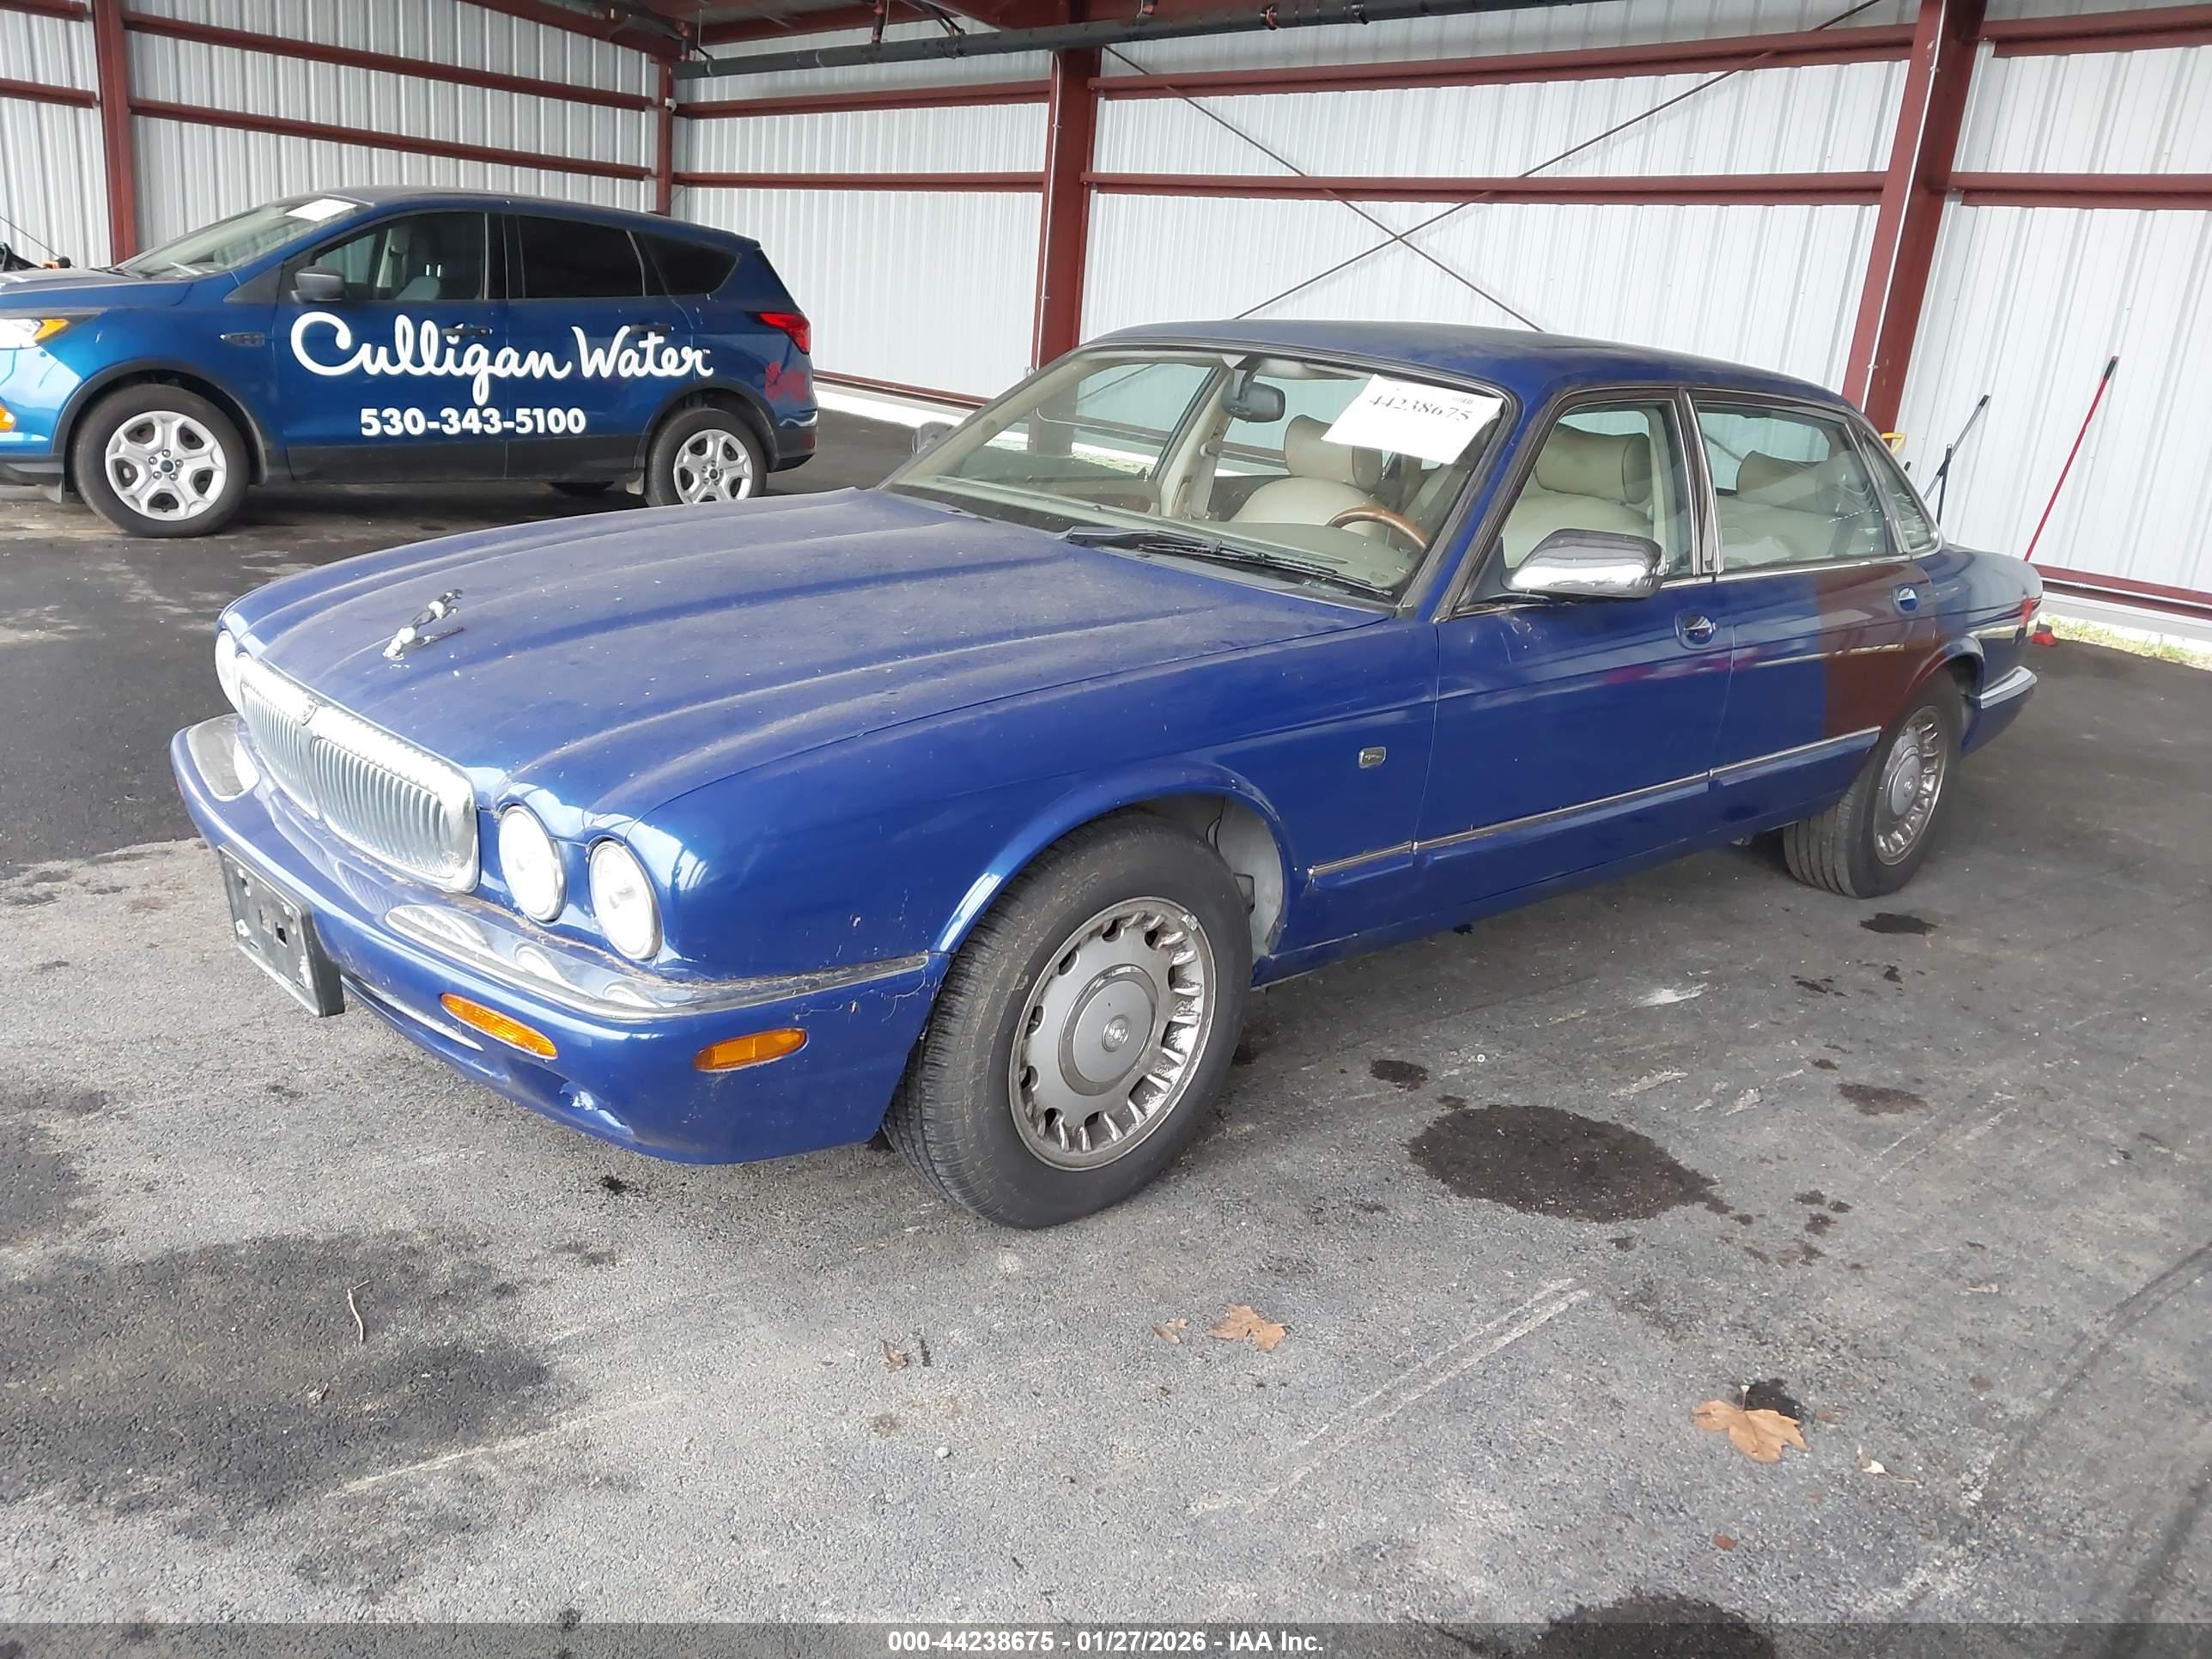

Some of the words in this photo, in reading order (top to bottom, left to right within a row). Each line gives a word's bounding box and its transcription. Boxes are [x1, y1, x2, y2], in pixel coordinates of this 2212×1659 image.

[290, 311, 572, 406] Culligan
[571, 325, 714, 379] Water
[361, 407, 586, 436] 530-343-5100
[1369, 395, 1474, 422] 44238675
